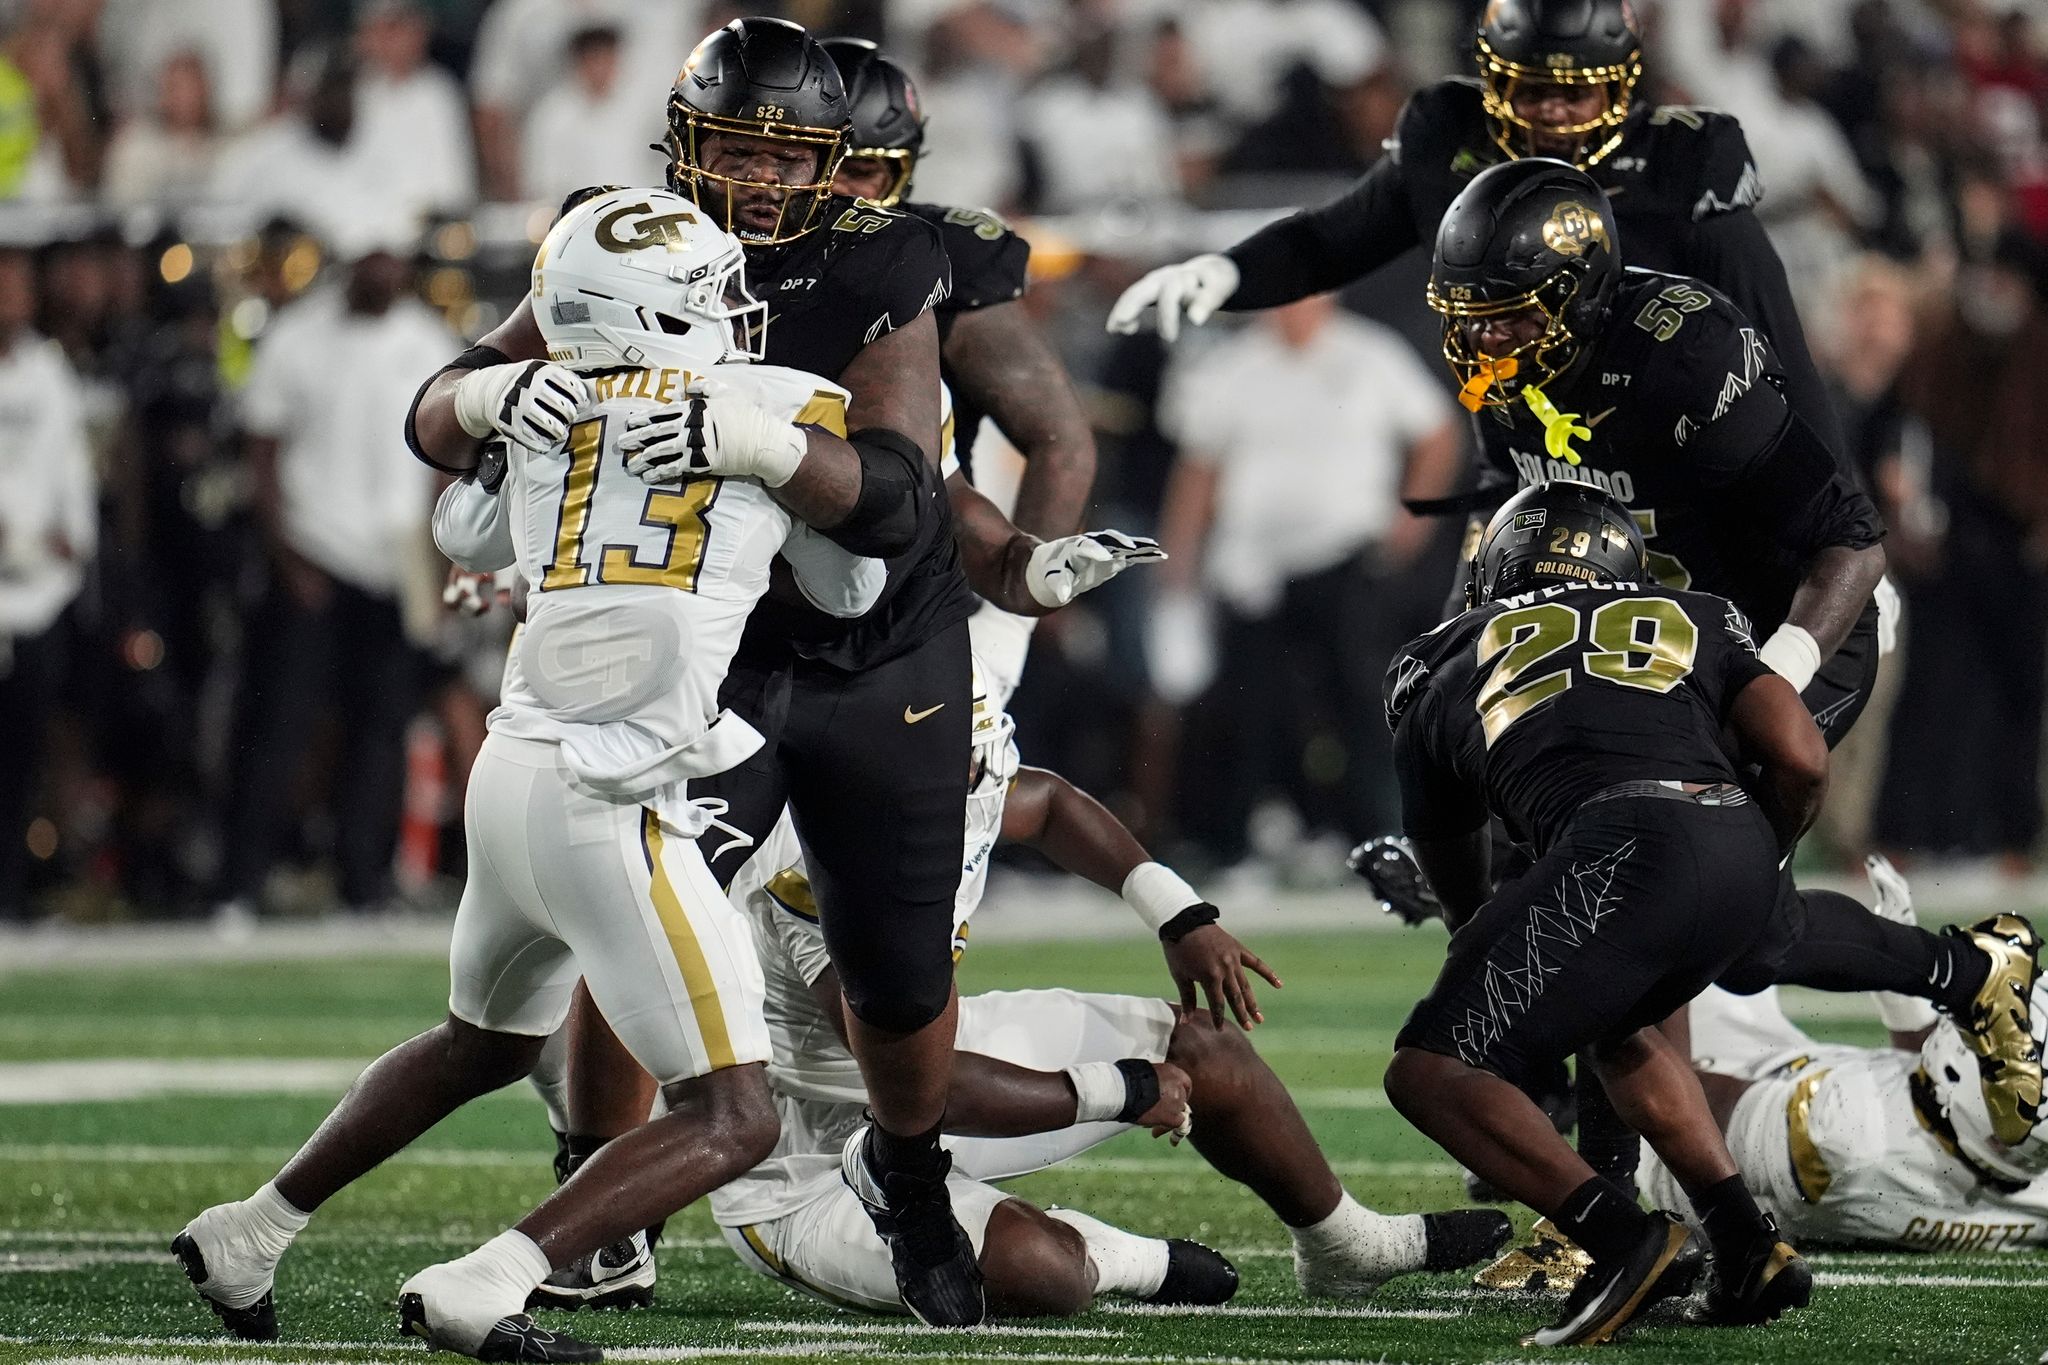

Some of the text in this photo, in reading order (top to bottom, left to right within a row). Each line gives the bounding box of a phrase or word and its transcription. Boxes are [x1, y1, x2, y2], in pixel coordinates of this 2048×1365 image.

[594, 202, 699, 255] GT
[780, 278, 817, 290] DP 7
[1633, 284, 1712, 342] 55
[1602, 373, 1632, 387] DP 7
[540, 415, 724, 594] 13
[1549, 526, 1591, 558] 29
[1535, 561, 1597, 583] COLORADO
[1476, 597, 1699, 751] 29
